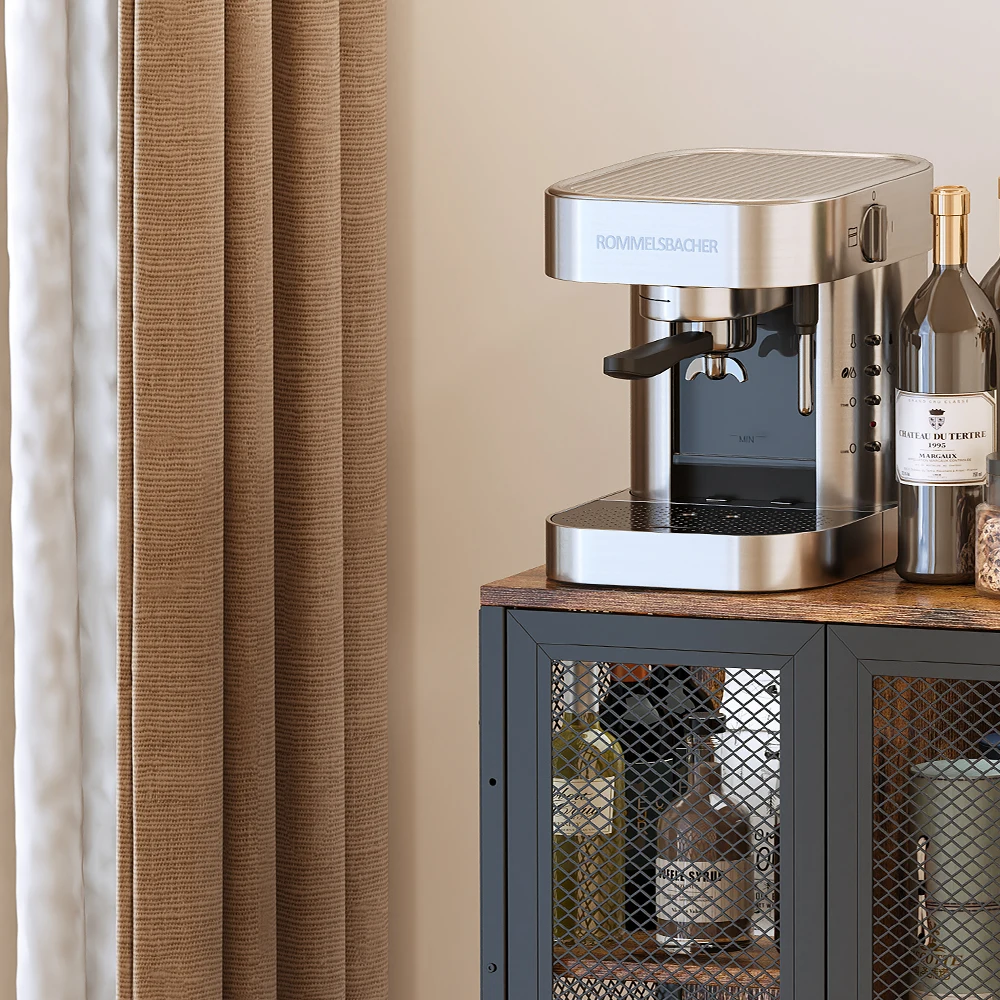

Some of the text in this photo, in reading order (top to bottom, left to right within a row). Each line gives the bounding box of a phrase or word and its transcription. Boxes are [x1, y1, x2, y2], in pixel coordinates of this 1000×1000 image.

[596, 234, 719, 254] ROMMELSBACHER
[738, 435, 755, 444] MIN
[898, 429, 986, 441] CHATEAU DU TERTRE
